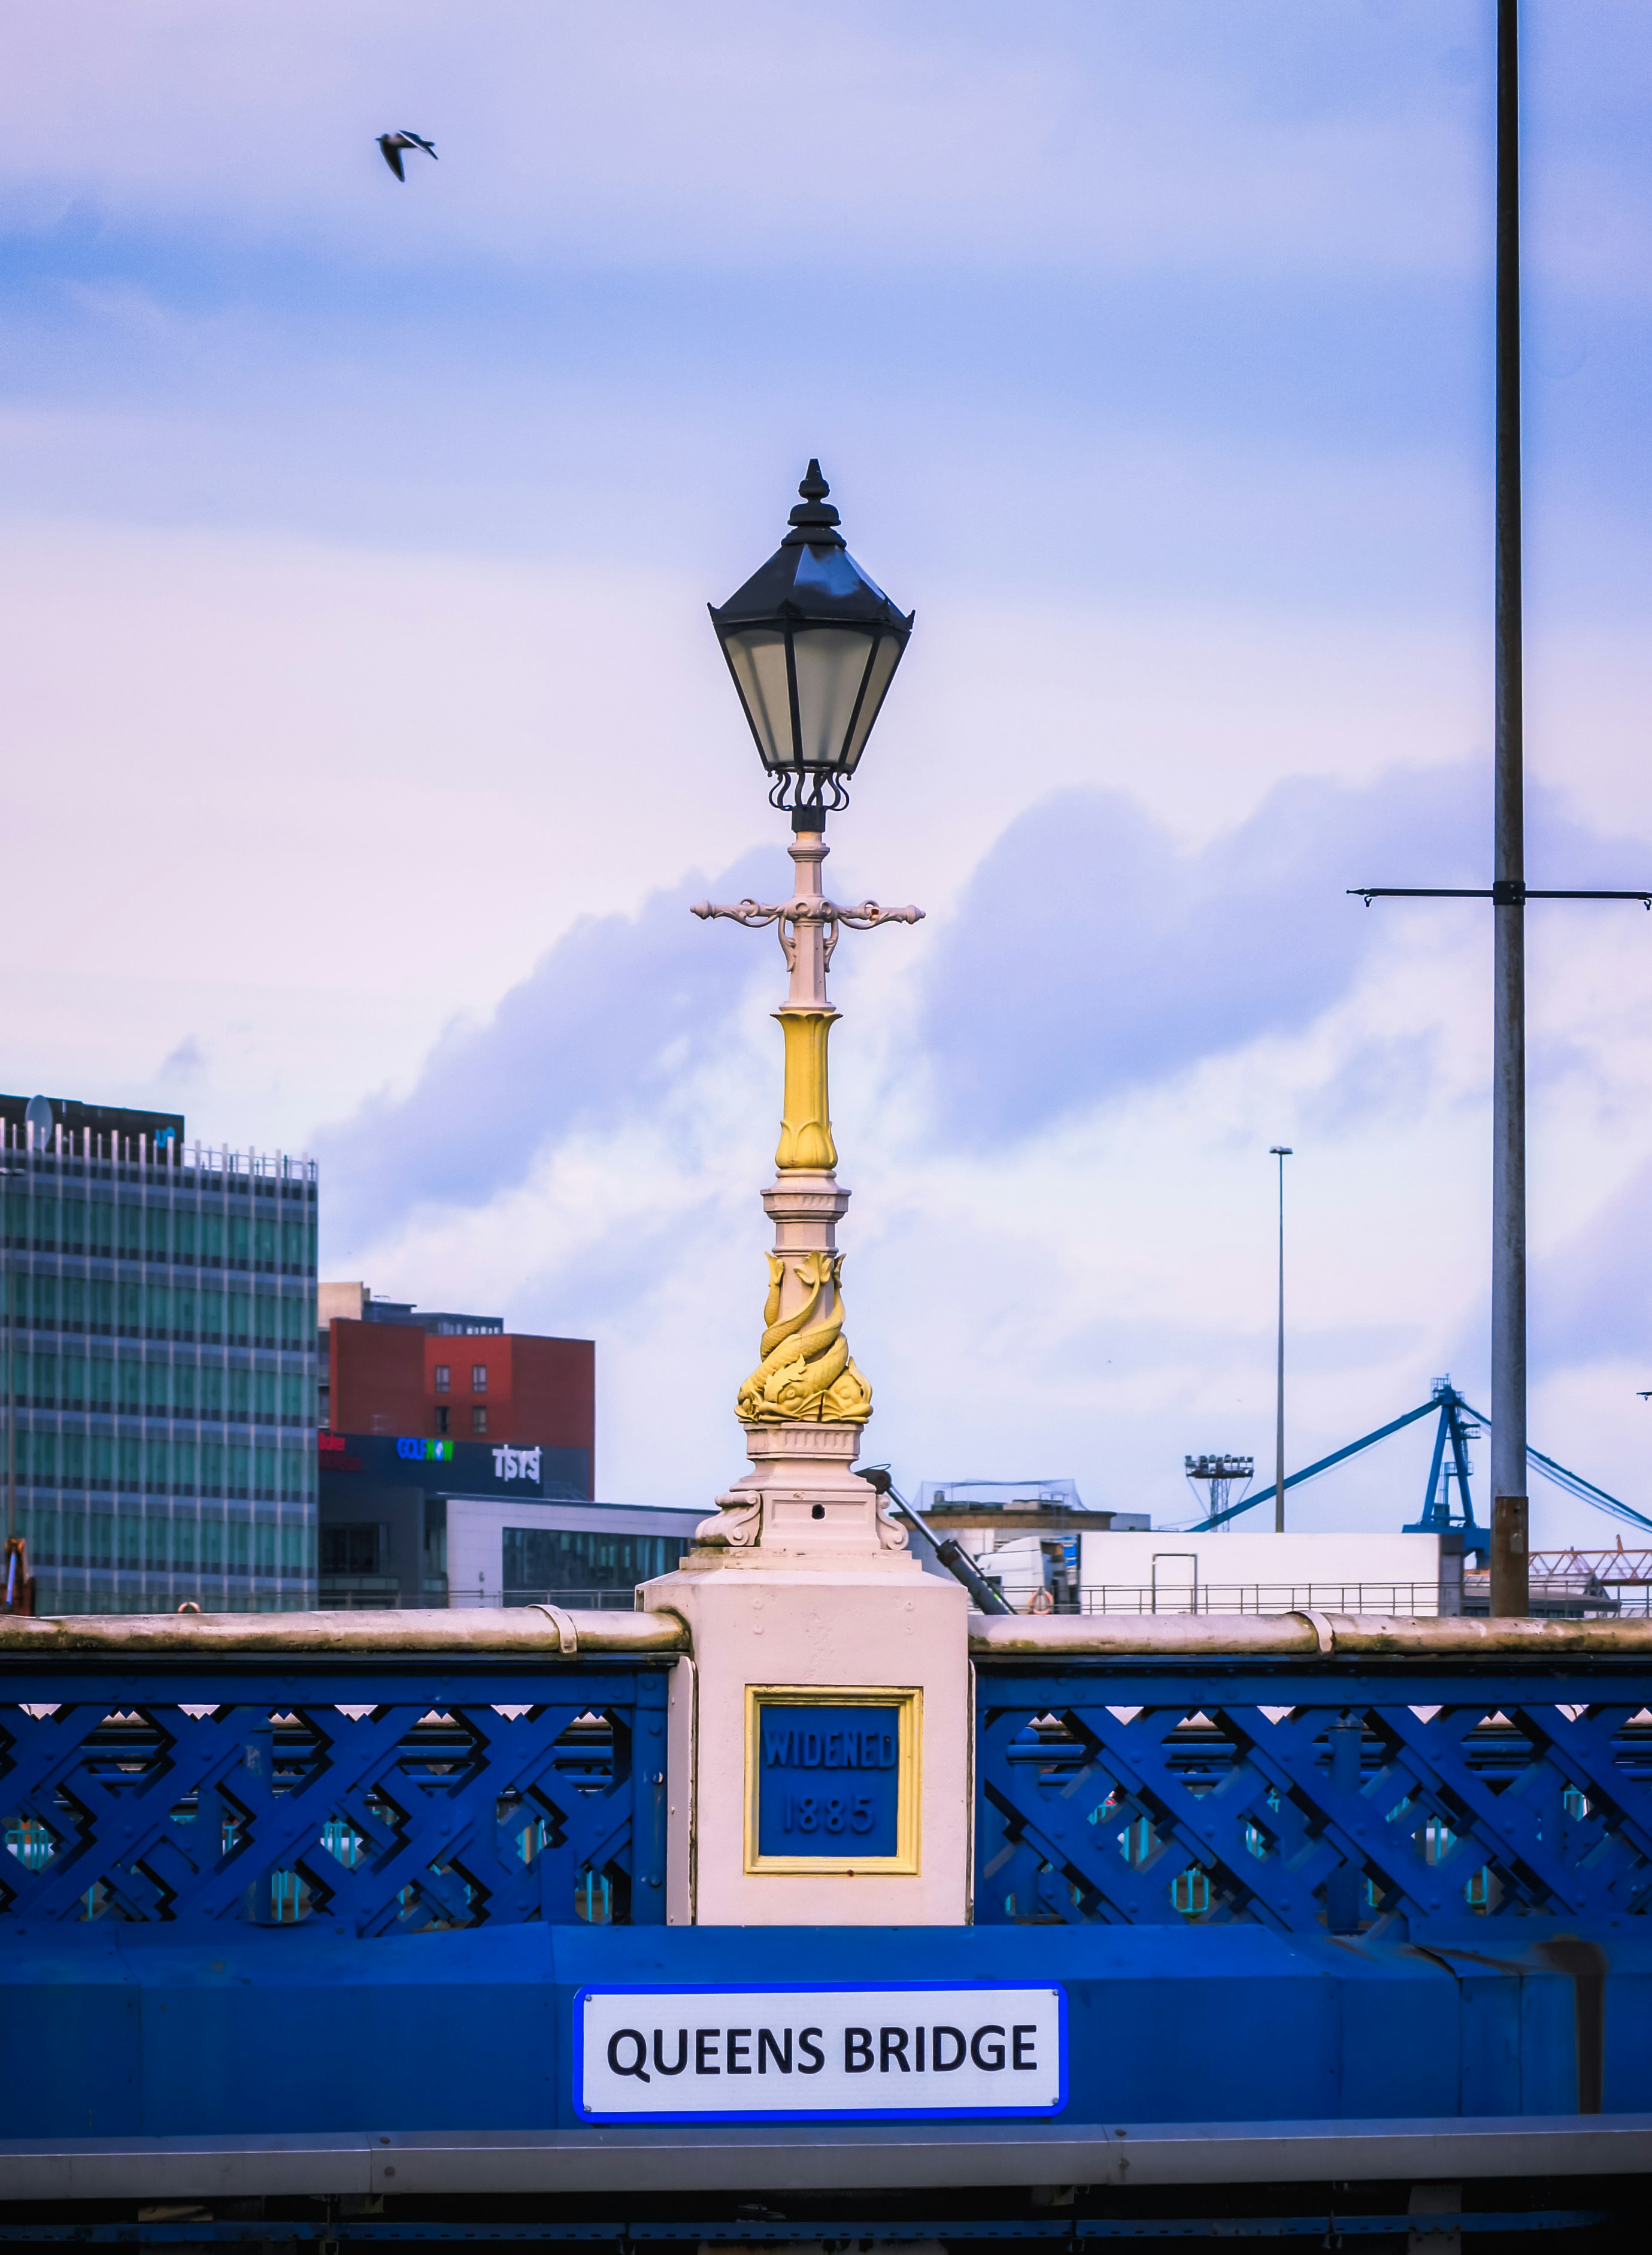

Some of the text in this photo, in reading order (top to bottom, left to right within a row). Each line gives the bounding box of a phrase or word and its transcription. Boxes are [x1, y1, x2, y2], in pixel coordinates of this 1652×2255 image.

[492, 1444, 542, 1484] TSYS
[762, 1730, 896, 1769] WIDENED
[784, 1795, 874, 1835] 1885
[607, 2024, 1038, 2083] QUEENS BRIDGE
